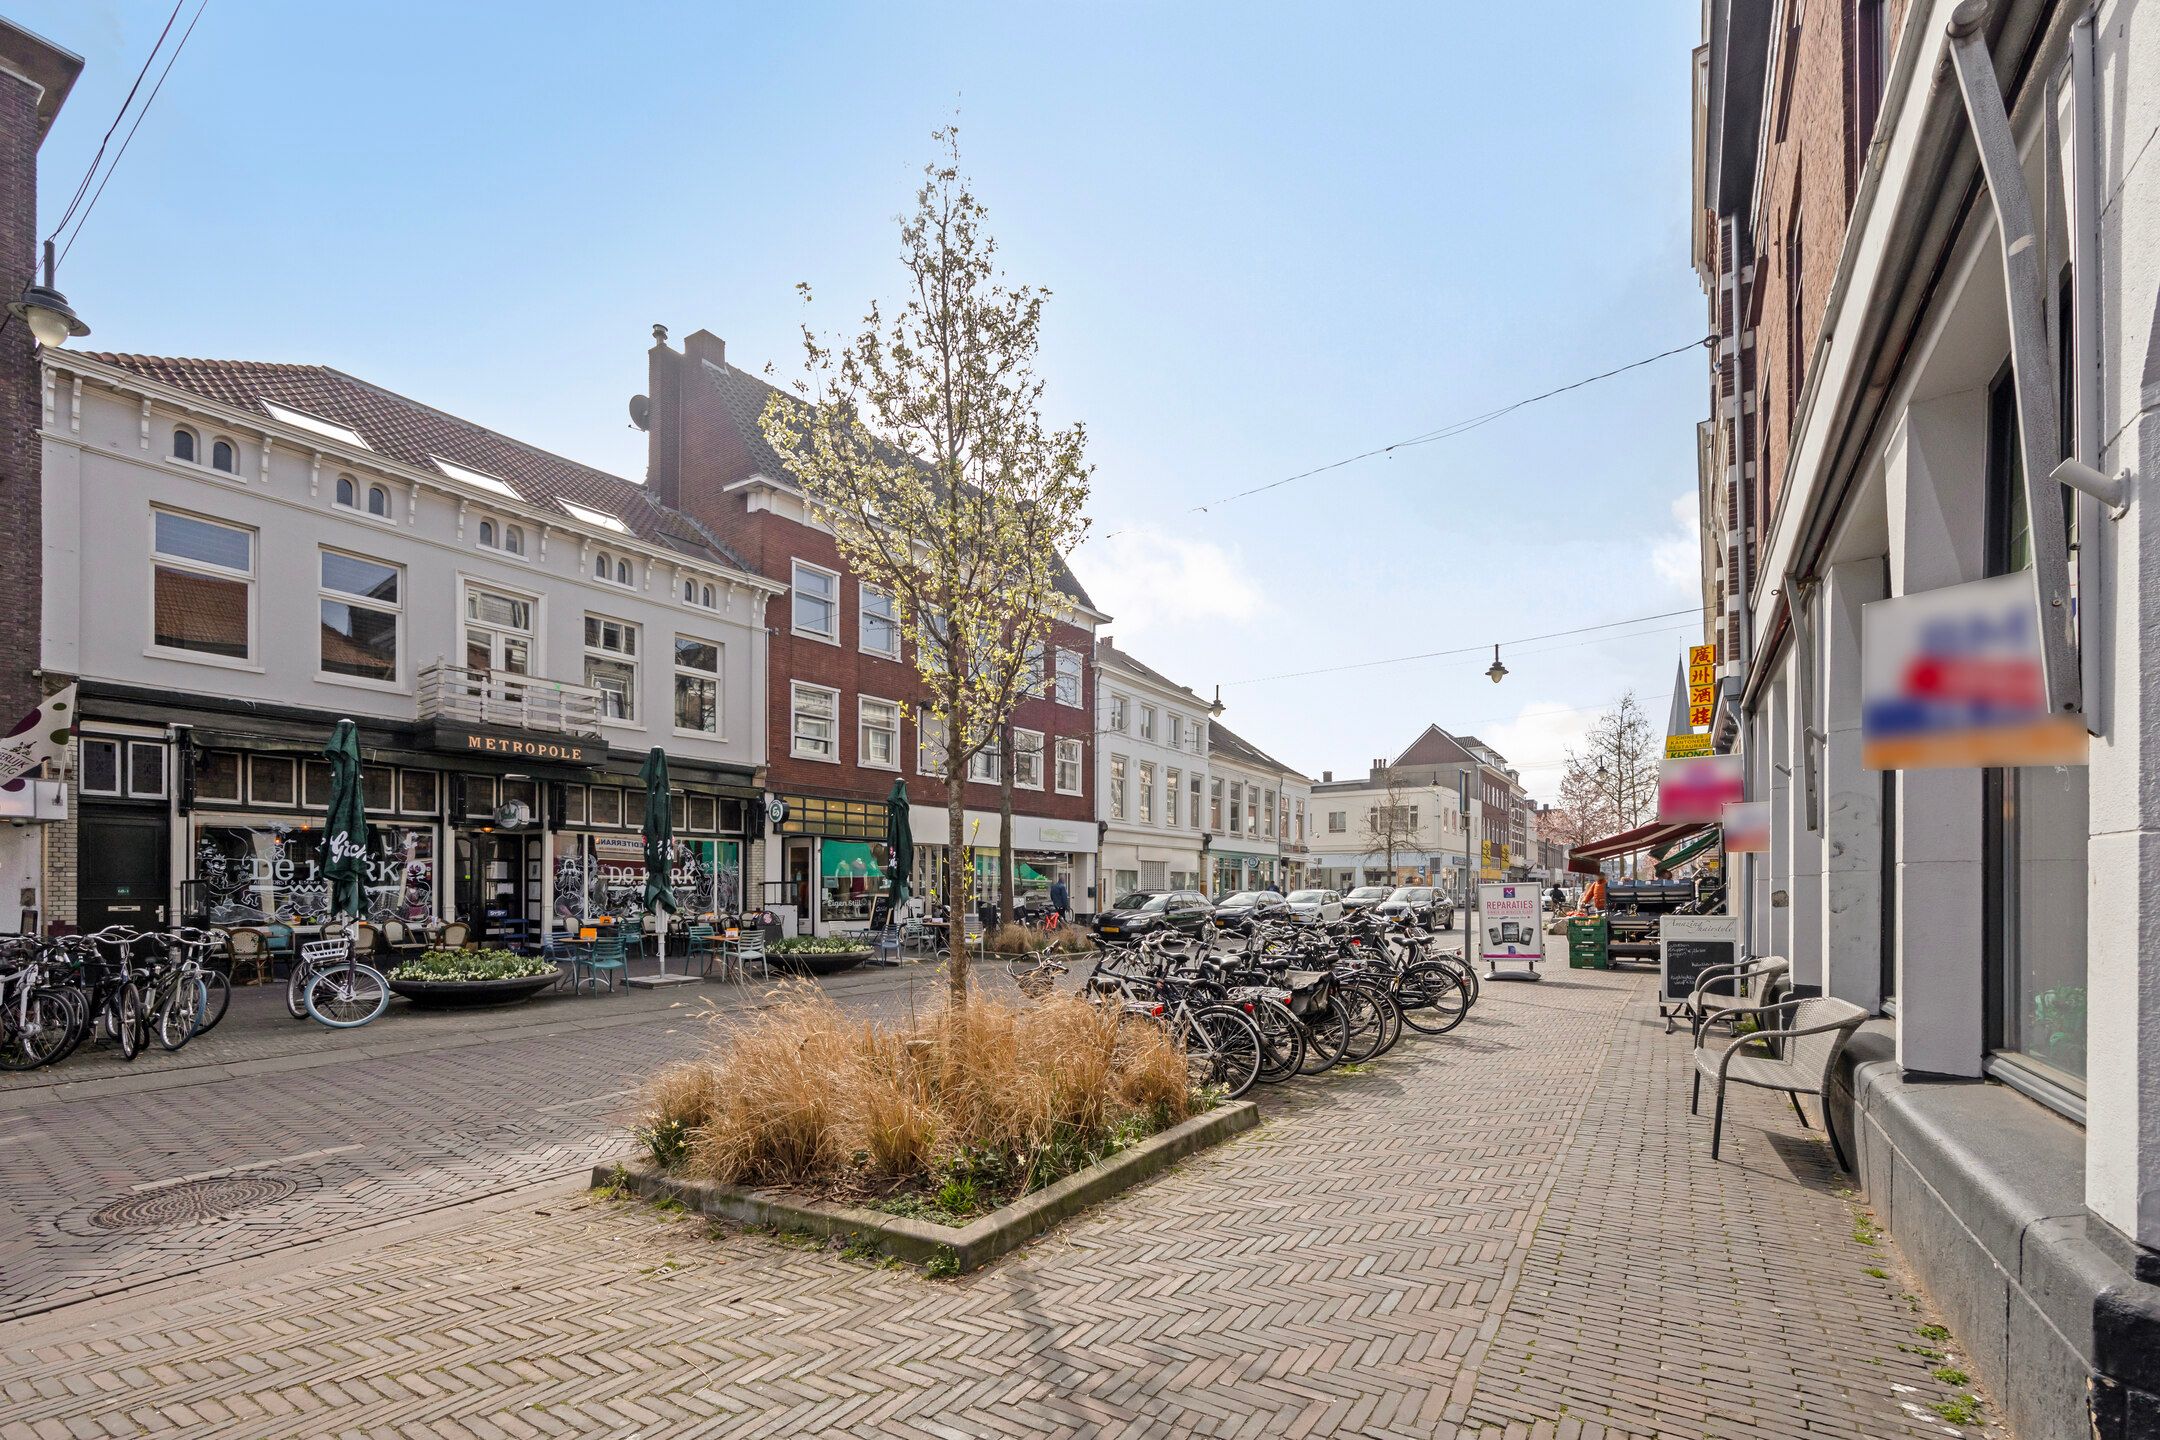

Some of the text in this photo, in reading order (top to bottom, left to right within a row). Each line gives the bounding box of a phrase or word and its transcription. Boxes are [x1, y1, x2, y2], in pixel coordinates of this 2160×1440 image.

[468, 736, 582, 760] METROPOLE
[1670, 750, 1709, 758] KWONG
[1486, 899, 1534, 910] REPARATIES
